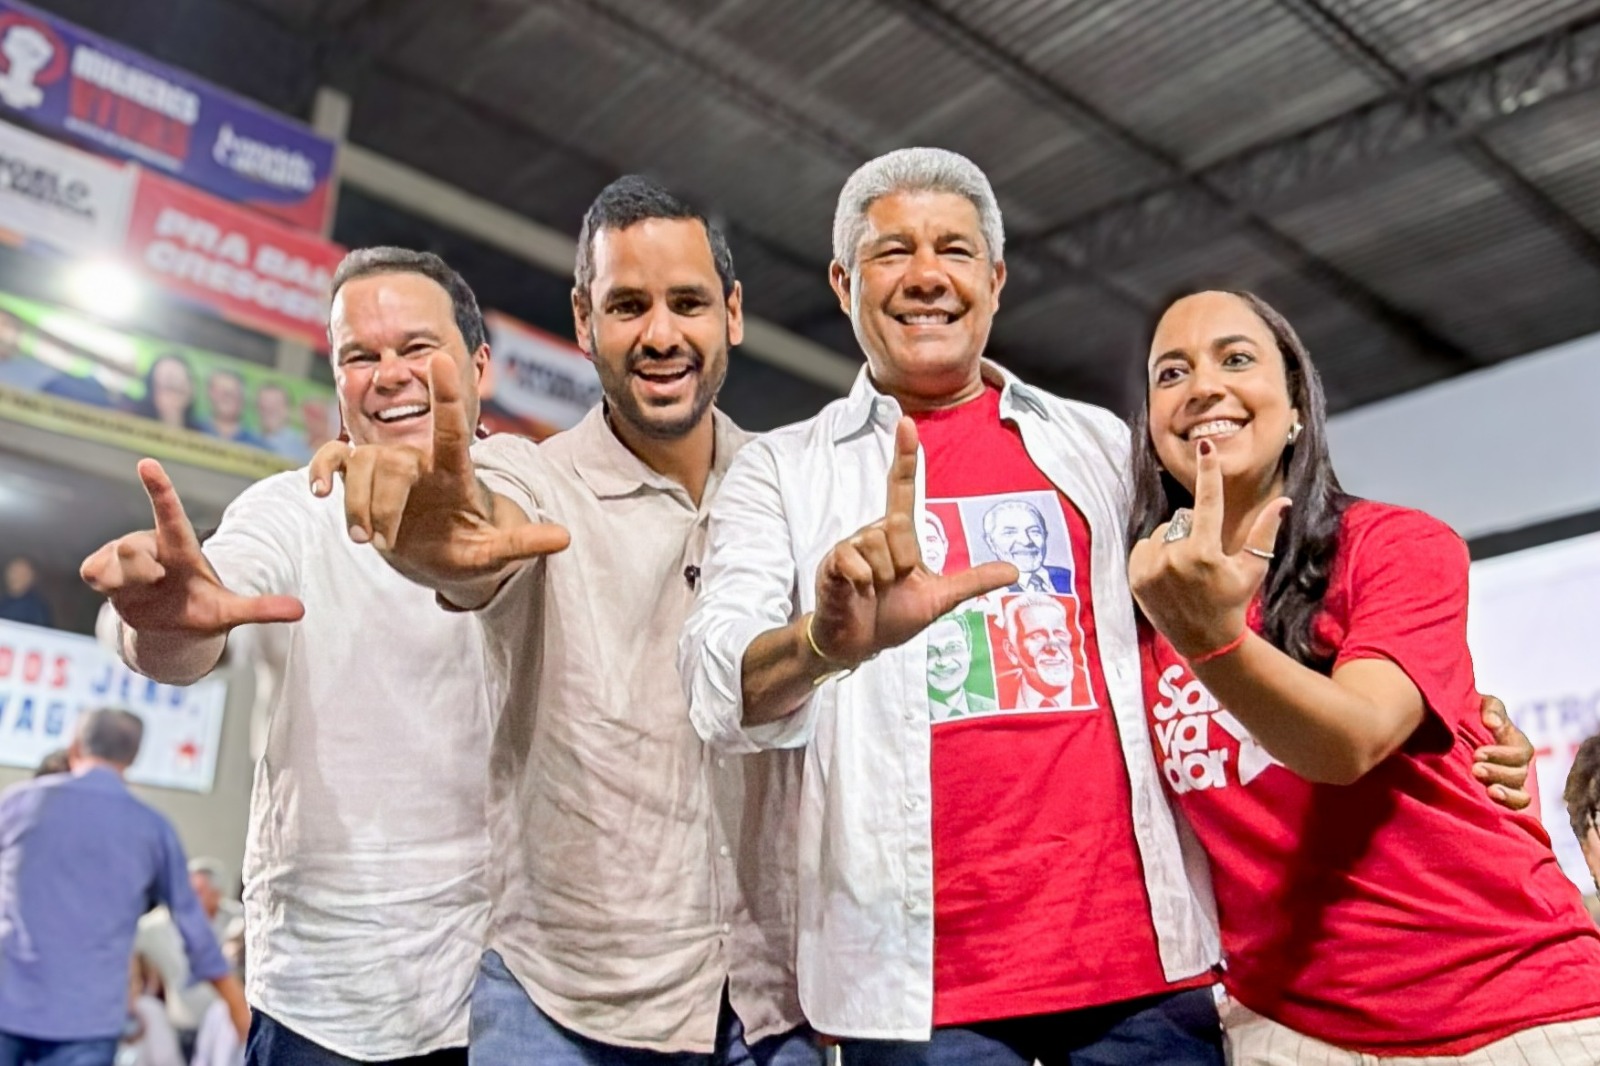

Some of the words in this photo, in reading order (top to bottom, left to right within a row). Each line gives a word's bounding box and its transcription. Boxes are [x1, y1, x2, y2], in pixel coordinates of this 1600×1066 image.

[154, 206, 248, 264] PRA
[1154, 714, 1208, 757] va
[1163, 740, 1228, 795] dor
